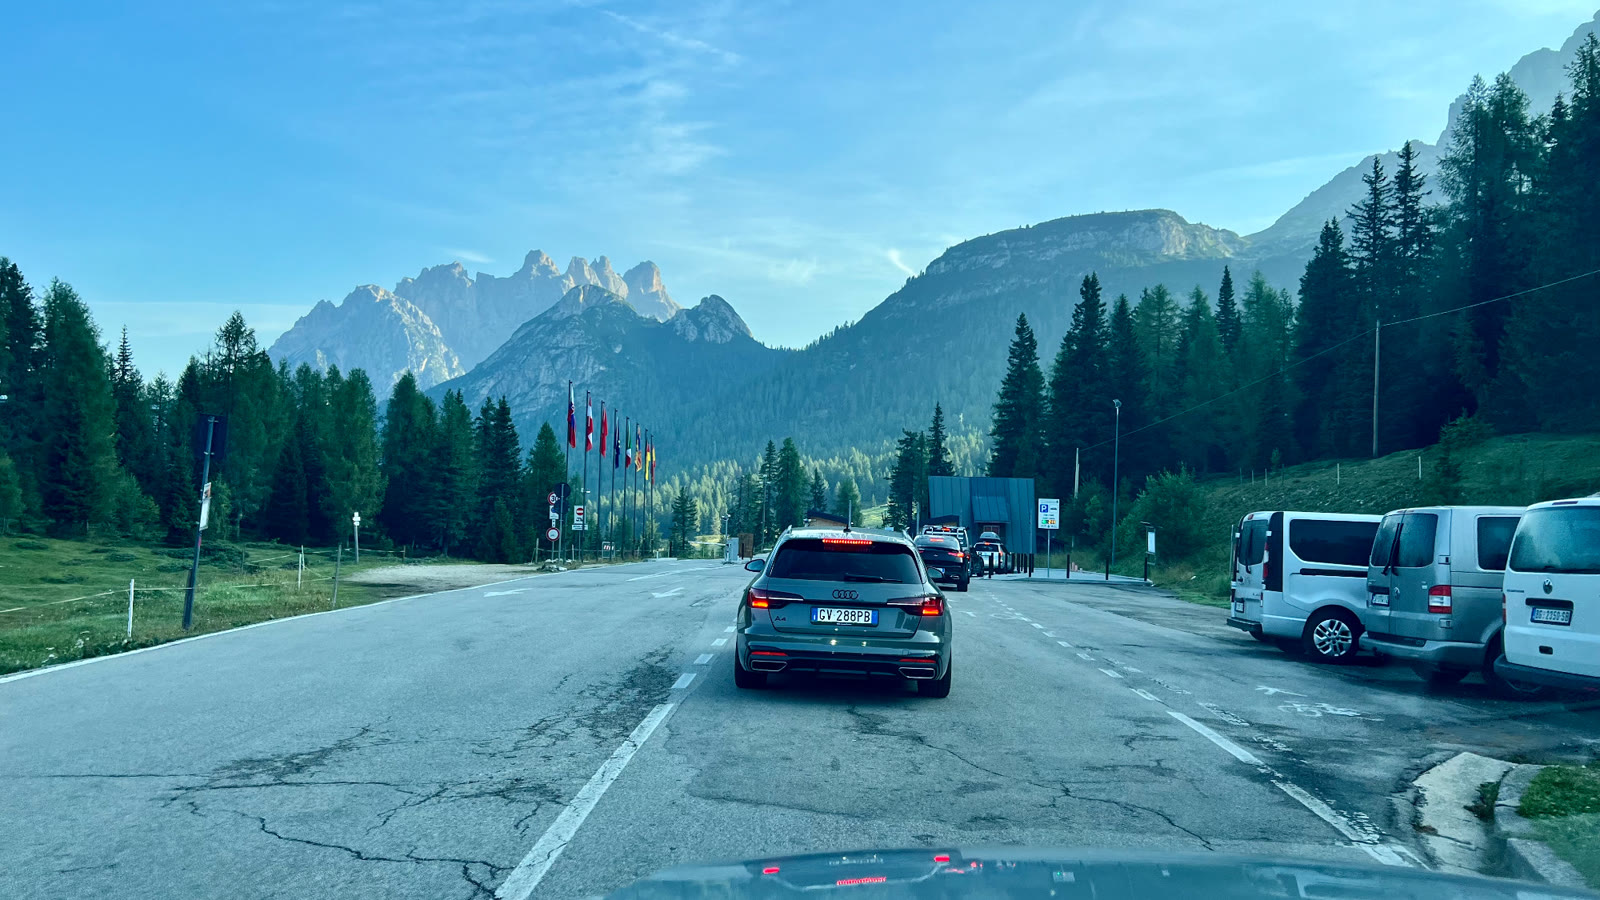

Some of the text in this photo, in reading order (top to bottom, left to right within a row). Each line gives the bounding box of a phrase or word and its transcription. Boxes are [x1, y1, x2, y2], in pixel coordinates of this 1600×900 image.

[1041, 504, 1048, 512] P
[819, 609, 871, 622] GV 288PB
